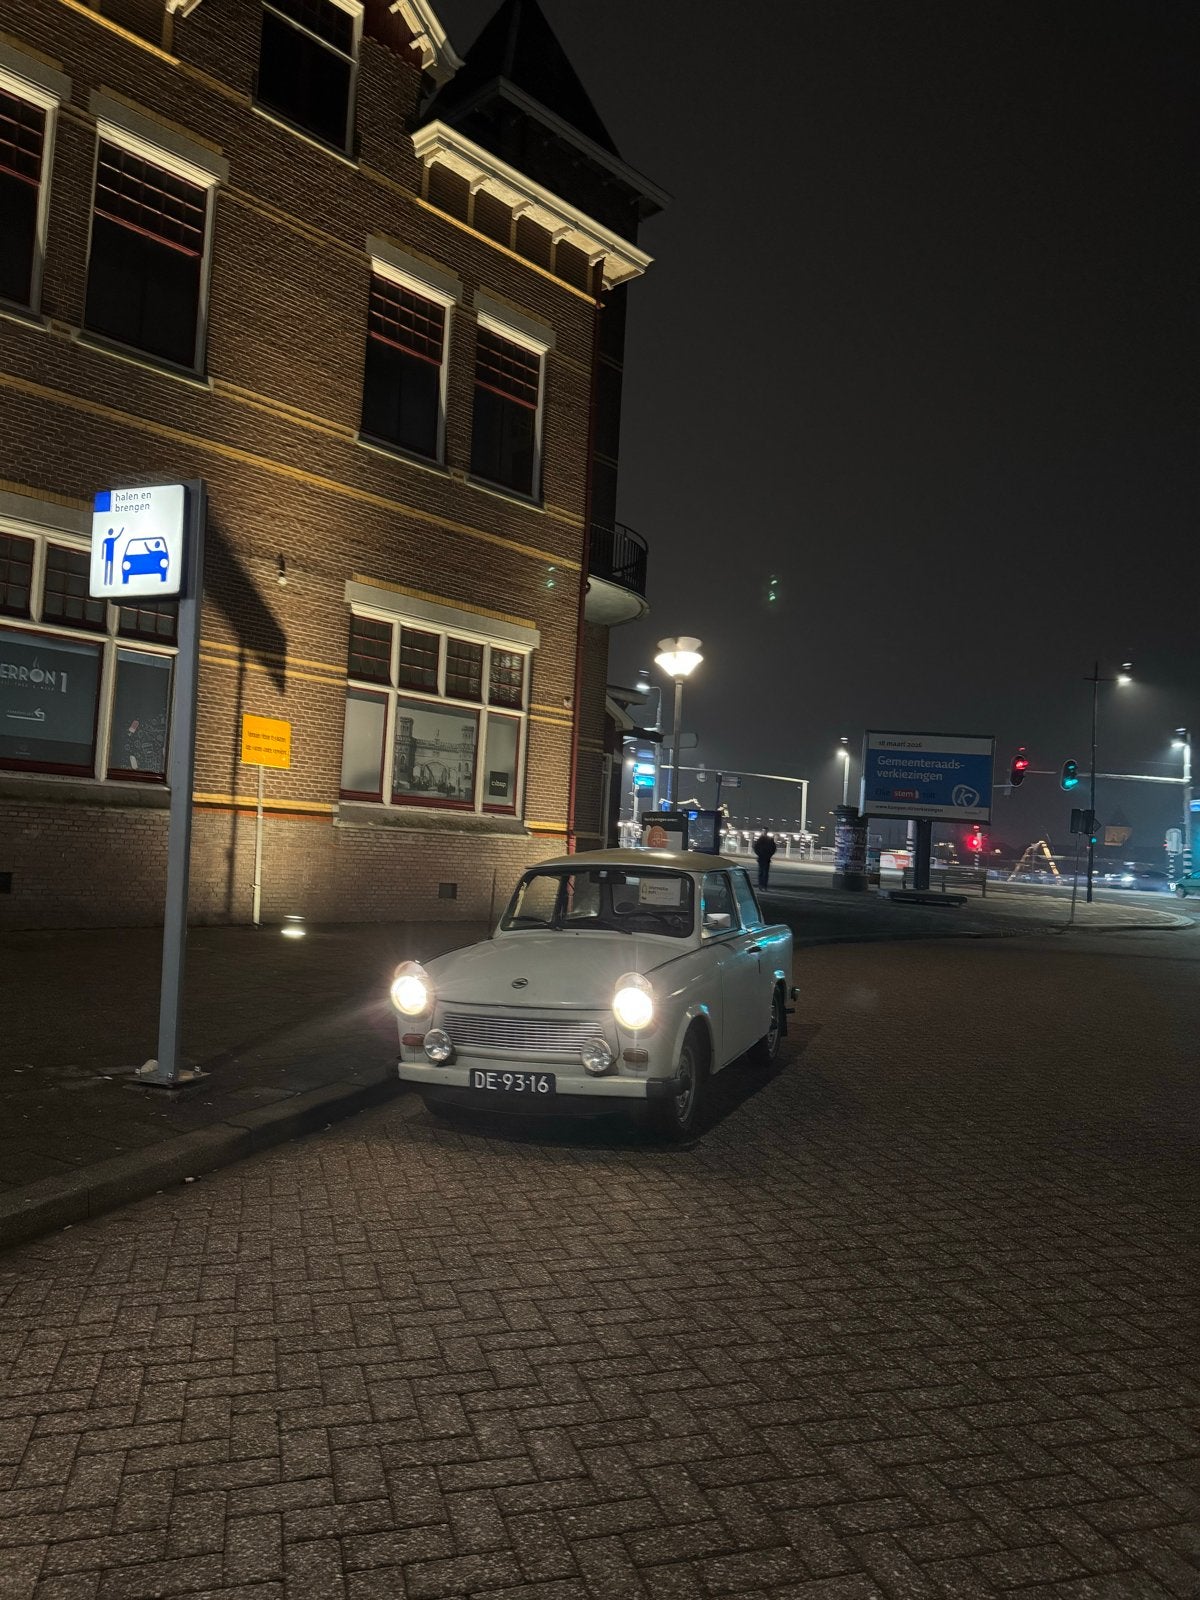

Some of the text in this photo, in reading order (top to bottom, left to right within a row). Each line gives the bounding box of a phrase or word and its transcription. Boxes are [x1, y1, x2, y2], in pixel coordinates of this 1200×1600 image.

[115, 492, 152, 502] halen en
[115, 503, 150, 513] brengen
[60, 671, 68, 693] 1
[887, 740, 906, 748] maart
[877, 755, 965, 770] Gemeenteraads-
[876, 768, 943, 783] verkiezingen
[893, 789, 914, 798] stem
[474, 1071, 549, 1094] DE-93-16
